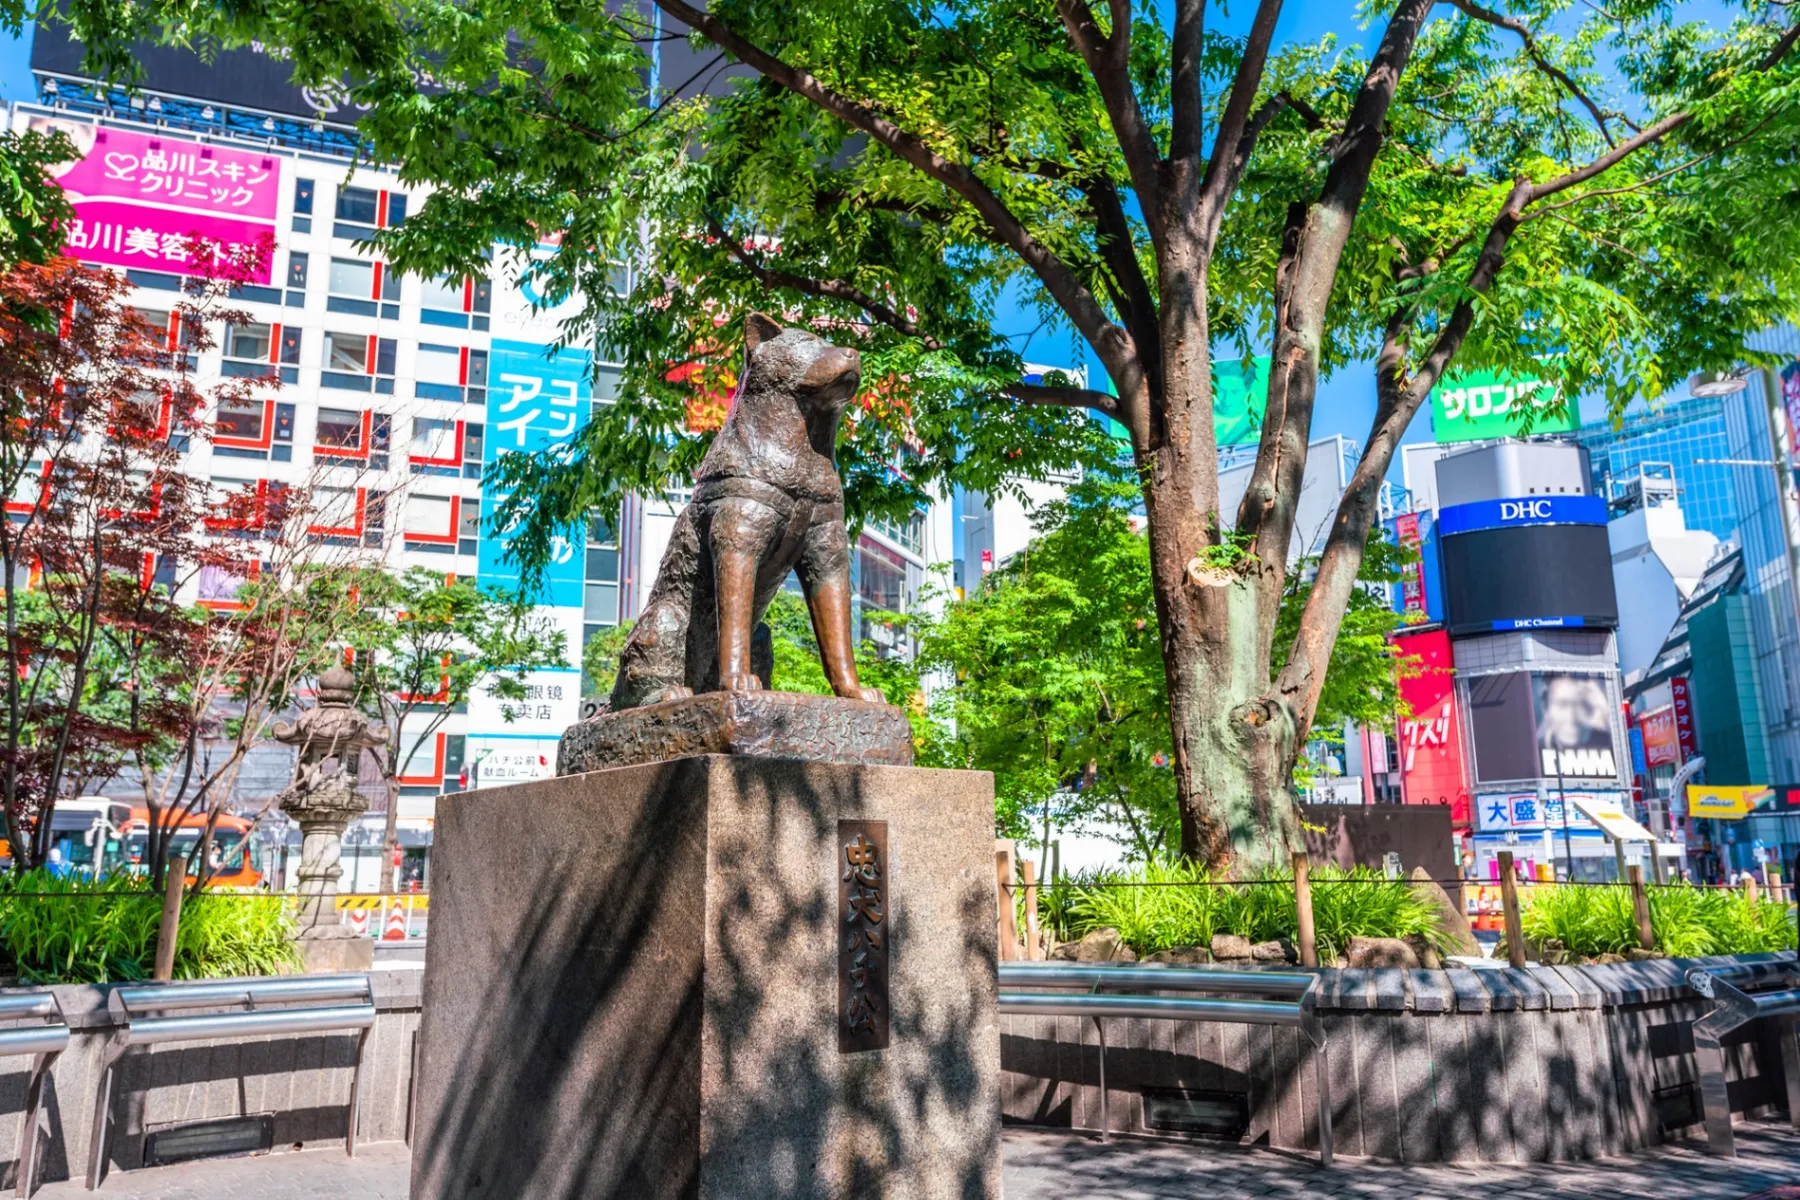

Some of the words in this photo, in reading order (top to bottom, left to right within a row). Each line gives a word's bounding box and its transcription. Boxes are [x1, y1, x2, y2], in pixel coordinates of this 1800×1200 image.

[141, 149, 269, 184] 品川スキン
[141, 173, 254, 206] クリニック
[1500, 500, 1551, 520] DHC
[1514, 619, 1532, 627] DHC
[1403, 703, 1451, 772] クスリ
[489, 755, 537, 766] ハチ公前
[483, 768, 539, 777] 献血ルーム
[1487, 799, 1590, 822] 大盛堂
[843, 833, 884, 1036] 忠犬ハチ公
